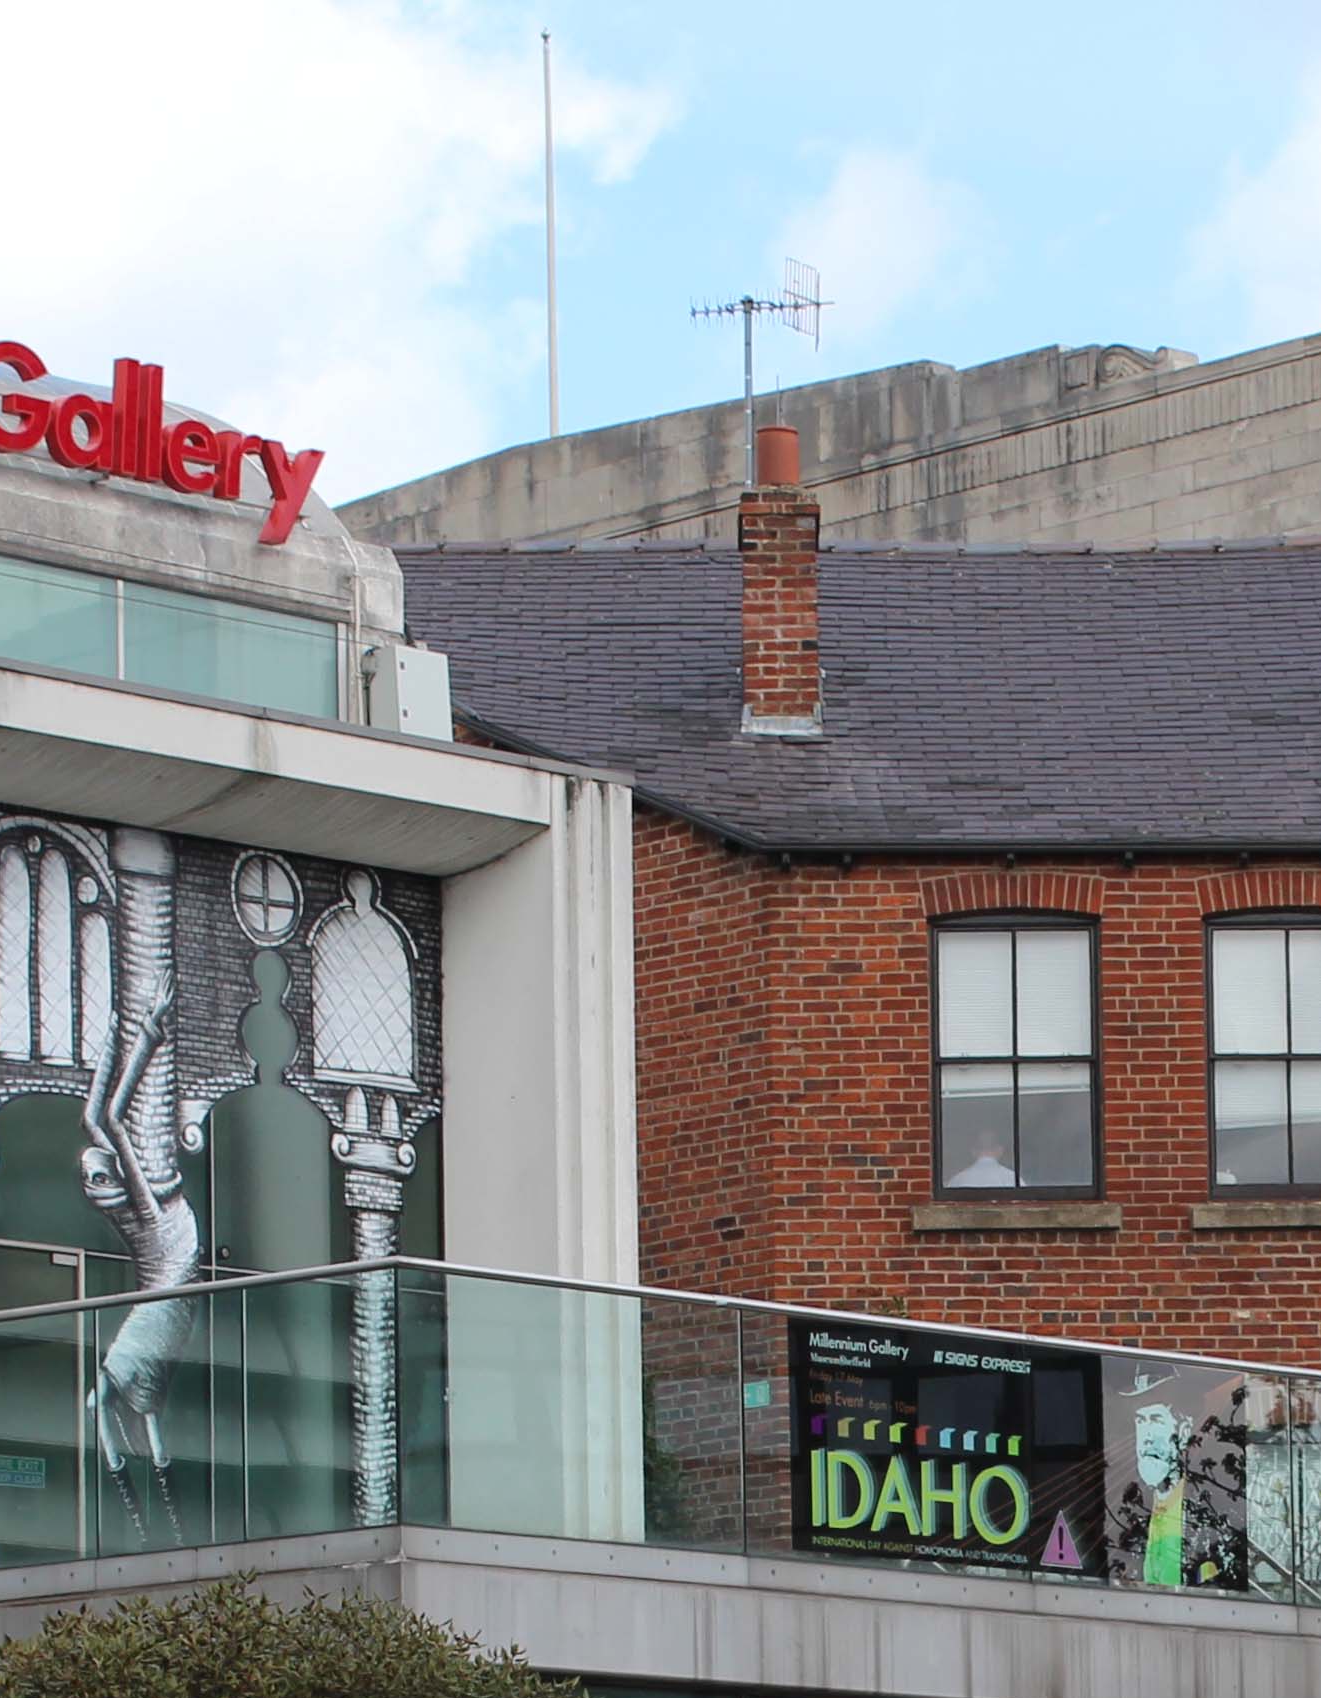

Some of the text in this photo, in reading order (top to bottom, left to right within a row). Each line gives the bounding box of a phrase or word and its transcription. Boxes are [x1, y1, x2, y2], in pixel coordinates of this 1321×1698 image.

[809, 1332, 910, 1361] Millennium Gallery
[944, 1351, 978, 1368] SIGNS
[834, 1390, 865, 1409] Event
[810, 1448, 1030, 1545] IDAHO
